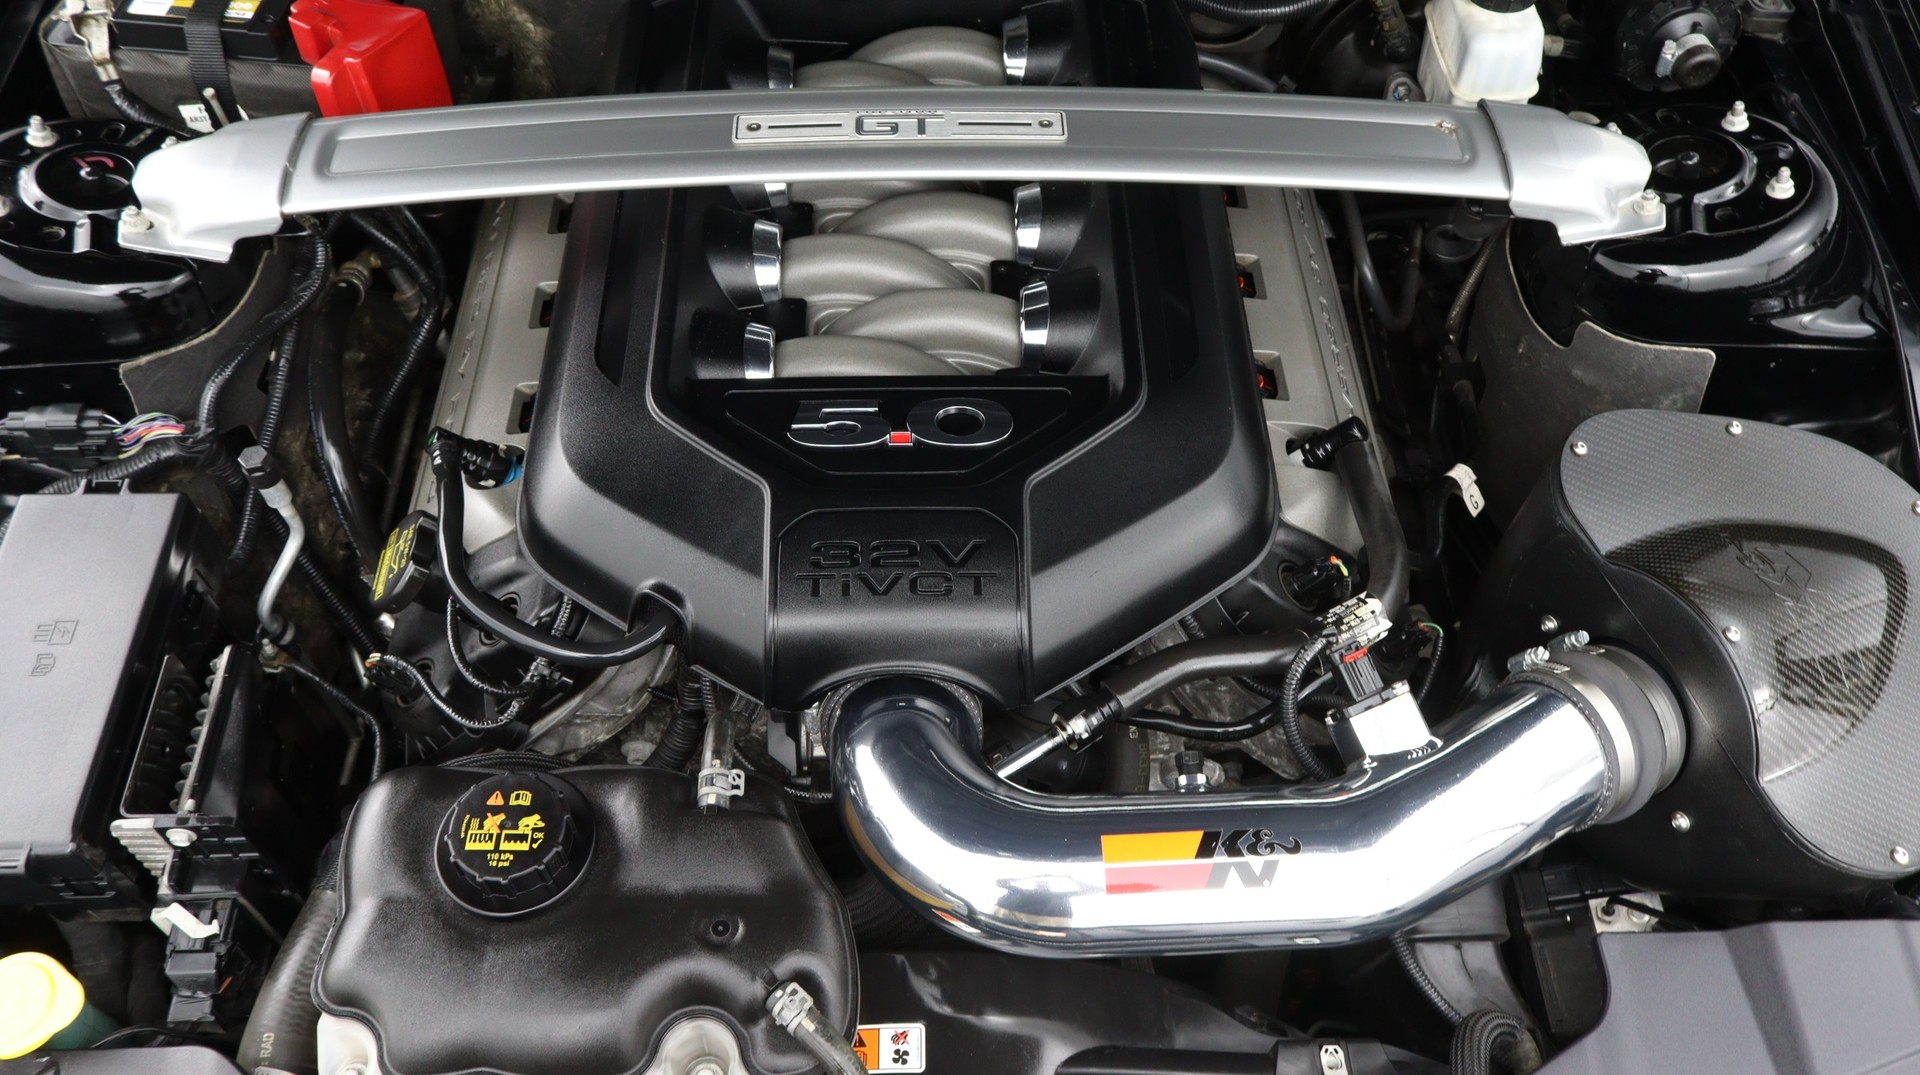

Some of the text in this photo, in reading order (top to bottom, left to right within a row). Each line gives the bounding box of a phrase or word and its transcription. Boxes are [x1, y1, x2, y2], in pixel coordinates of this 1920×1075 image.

[855, 114, 945, 137] GT
[787, 397, 1014, 448] 5.0
[1469, 494, 1480, 510] G
[810, 539, 987, 567] 32V
[486, 853, 514, 861] 110 kPa
[259, 1032, 275, 1058] RAD
